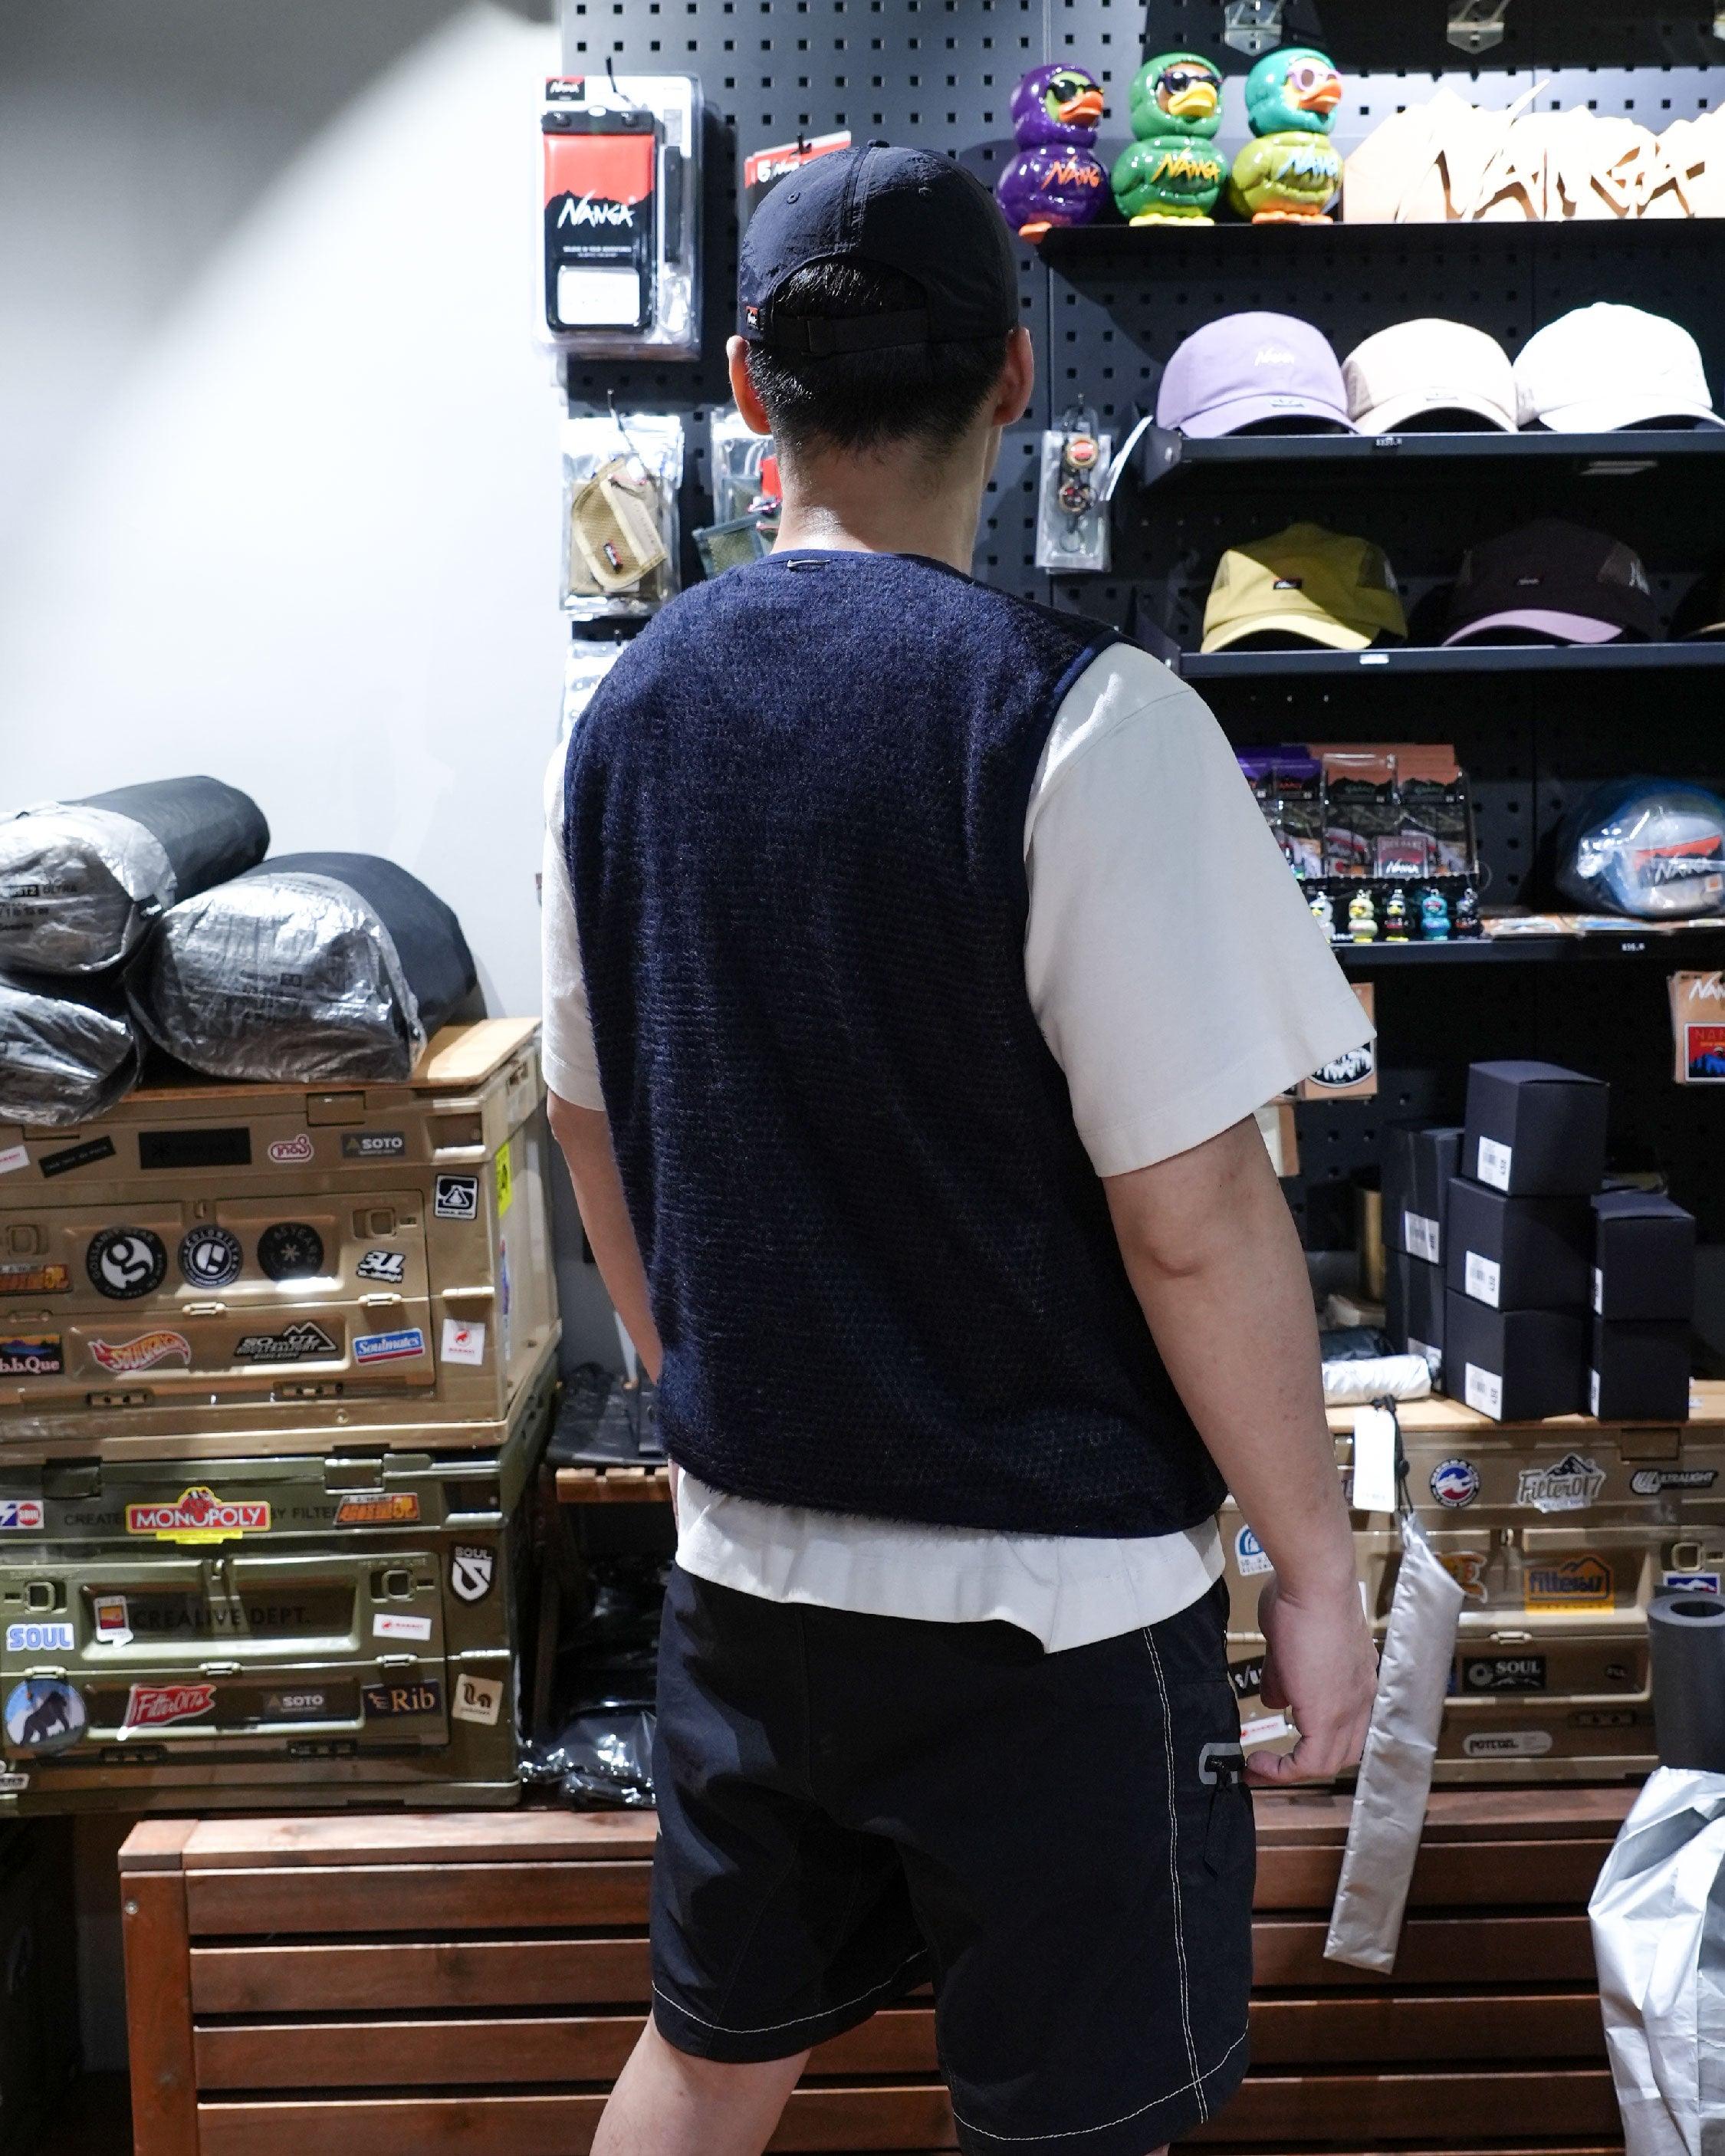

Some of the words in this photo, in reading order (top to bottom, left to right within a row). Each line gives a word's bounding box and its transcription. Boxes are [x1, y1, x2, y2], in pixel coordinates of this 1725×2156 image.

[557, 190, 636, 229] NANGA
[361, 1137, 403, 1150] SOTO
[136, 1507, 260, 1528] MONOPOLY
[455, 1546, 489, 1559] SOUL
[9, 1628, 71, 1648] SOUL
[1494, 1660, 1541, 1675] SOUL
[391, 1684, 435, 1712] Rib
